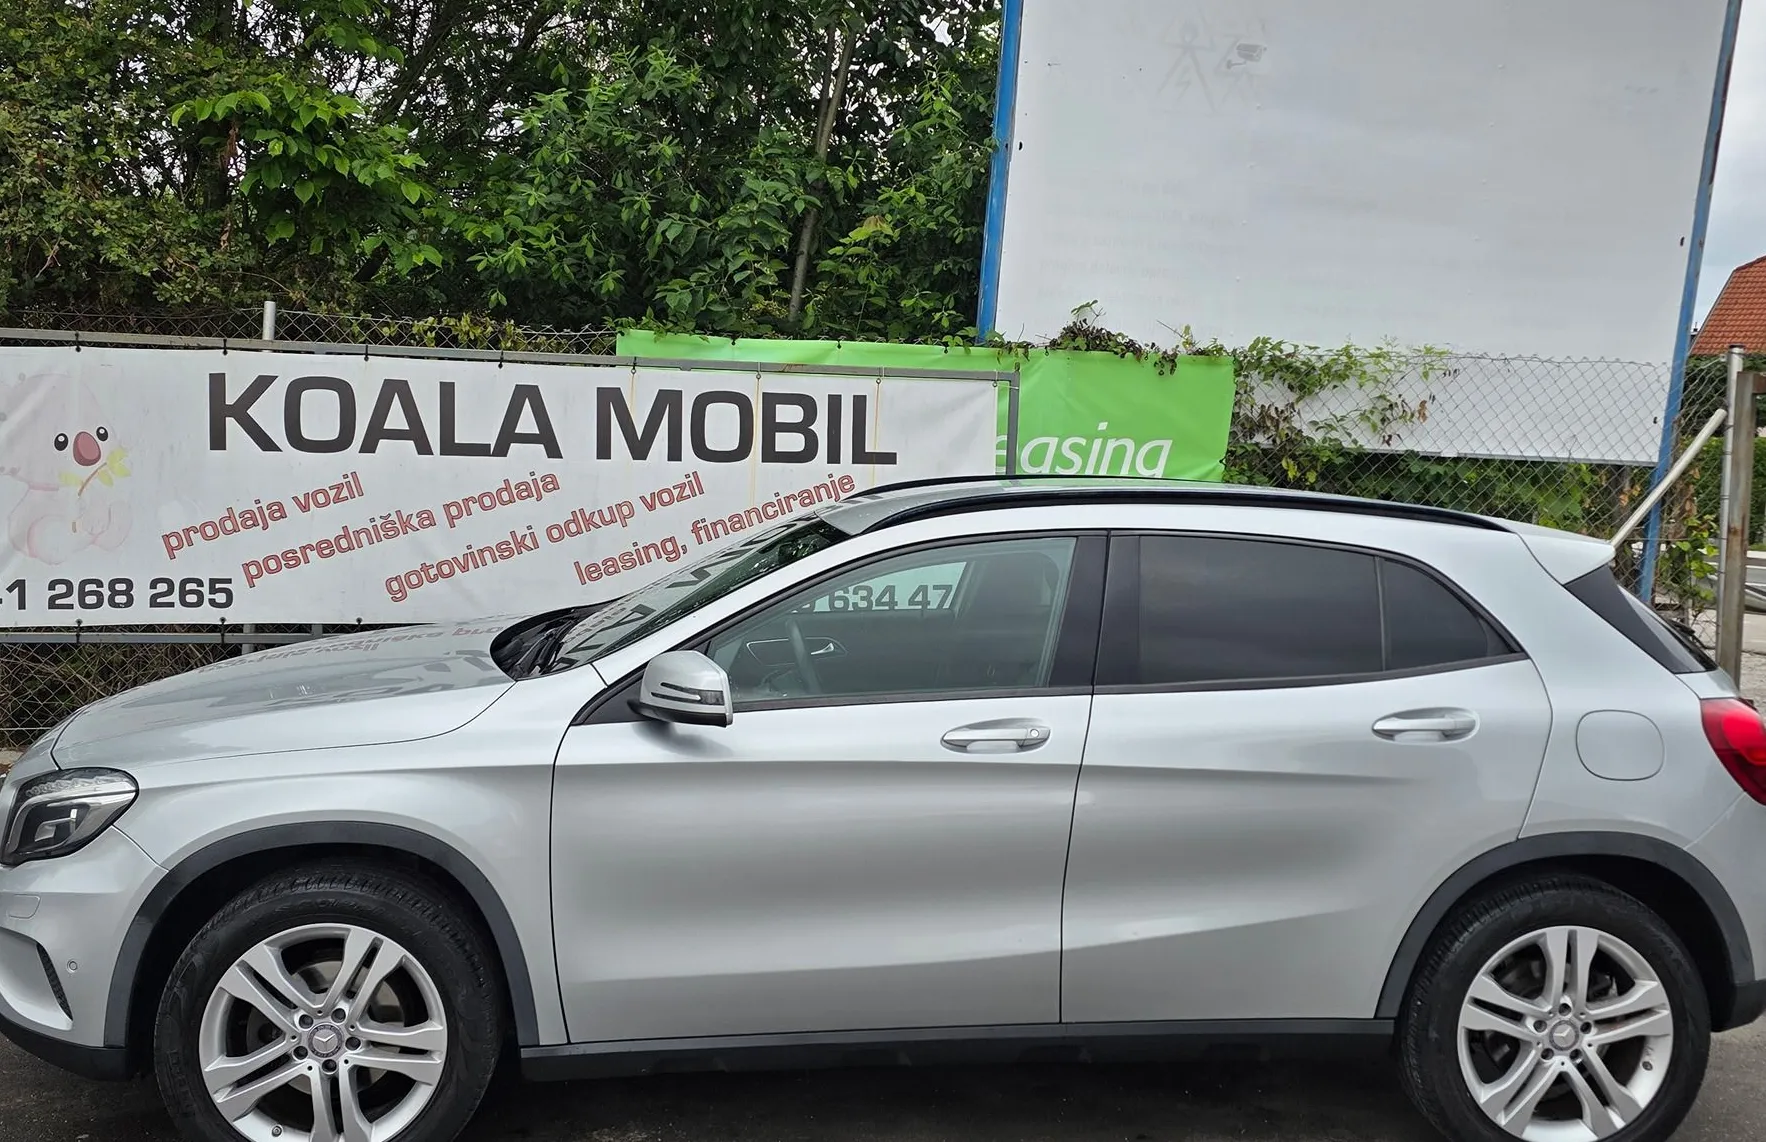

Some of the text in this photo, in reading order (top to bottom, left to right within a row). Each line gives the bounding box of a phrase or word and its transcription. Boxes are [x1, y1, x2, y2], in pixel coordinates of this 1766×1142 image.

[208, 372, 898, 465] KOALA MOBIL
[162, 471, 364, 560] prodaja vozil
[241, 471, 560, 588] posredniška prodaja
[385, 470, 705, 602] gotovinski odkup vozil
[573, 473, 856, 586] leasing, financiranje
[47, 578, 134, 610] 268
[149, 577, 234, 609] 265
[828, 584, 898, 611] 634
